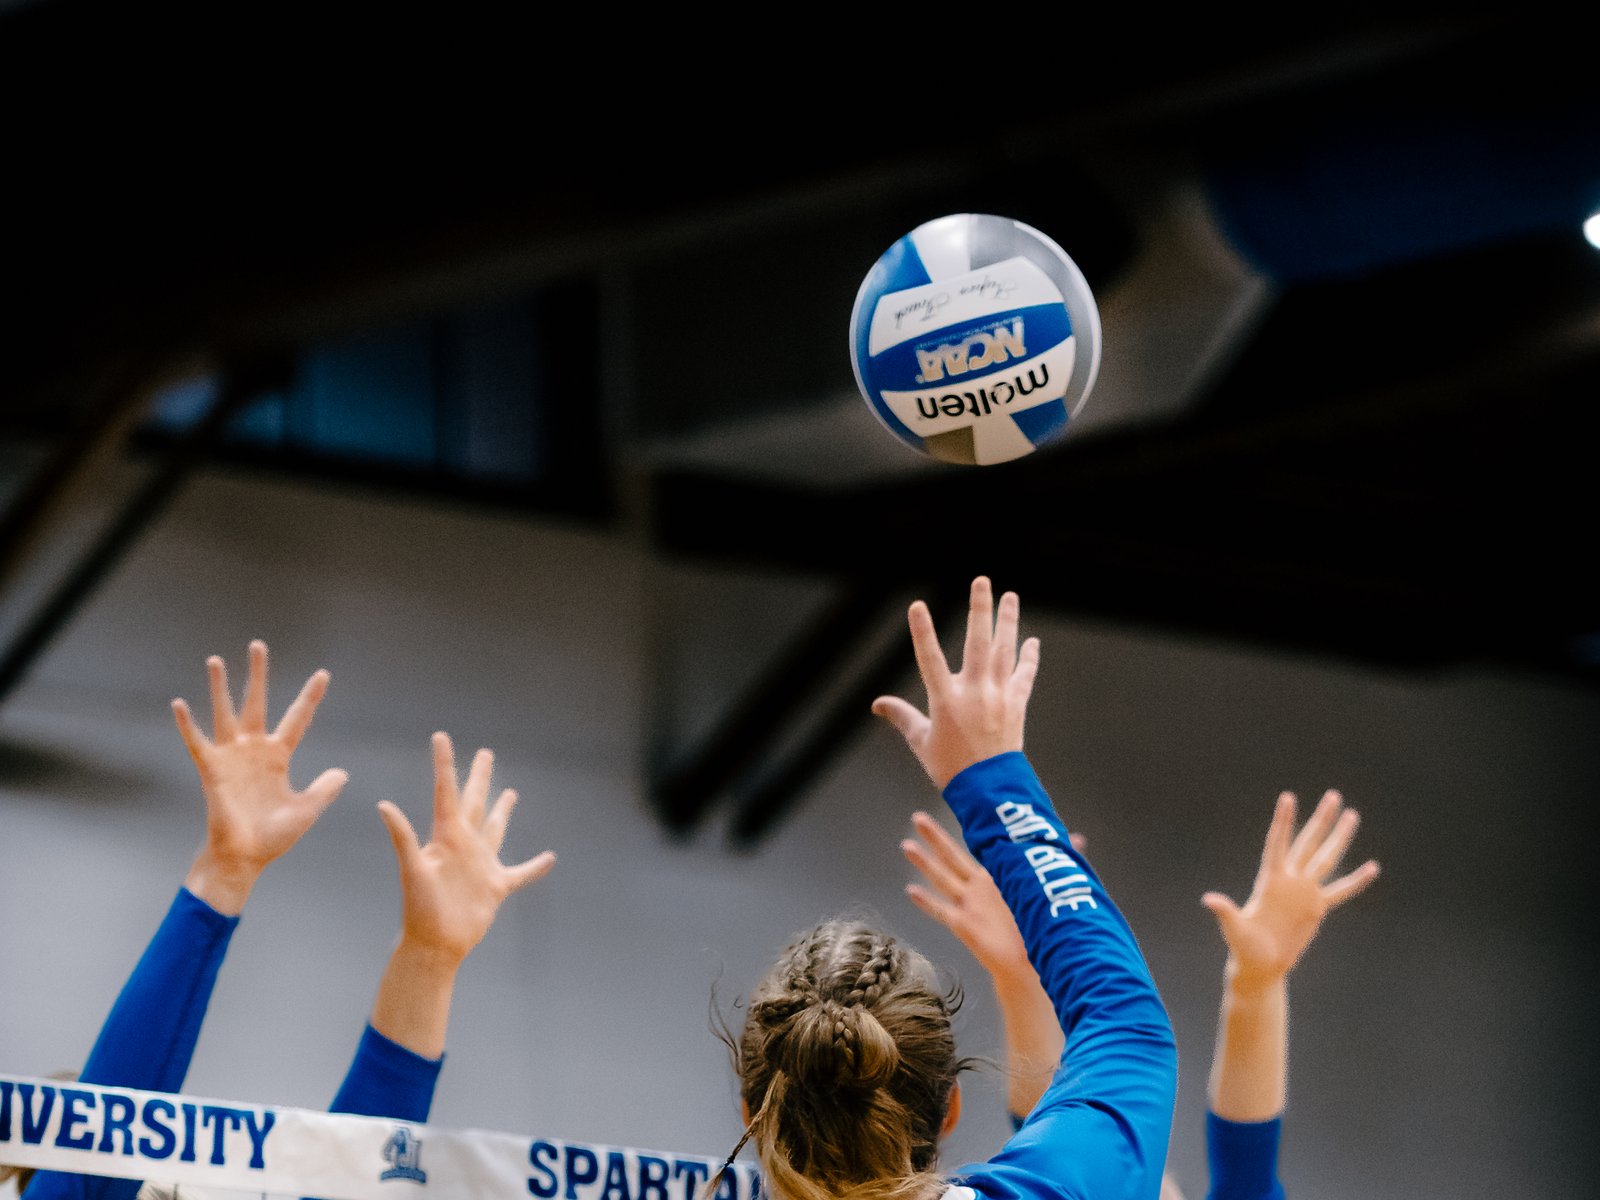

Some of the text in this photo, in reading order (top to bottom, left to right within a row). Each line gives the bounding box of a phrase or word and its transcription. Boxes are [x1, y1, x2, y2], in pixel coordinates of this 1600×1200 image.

[917, 318, 1026, 383] NCAA
[917, 363, 1050, 419] molten
[1024, 845, 1098, 918] BLUE
